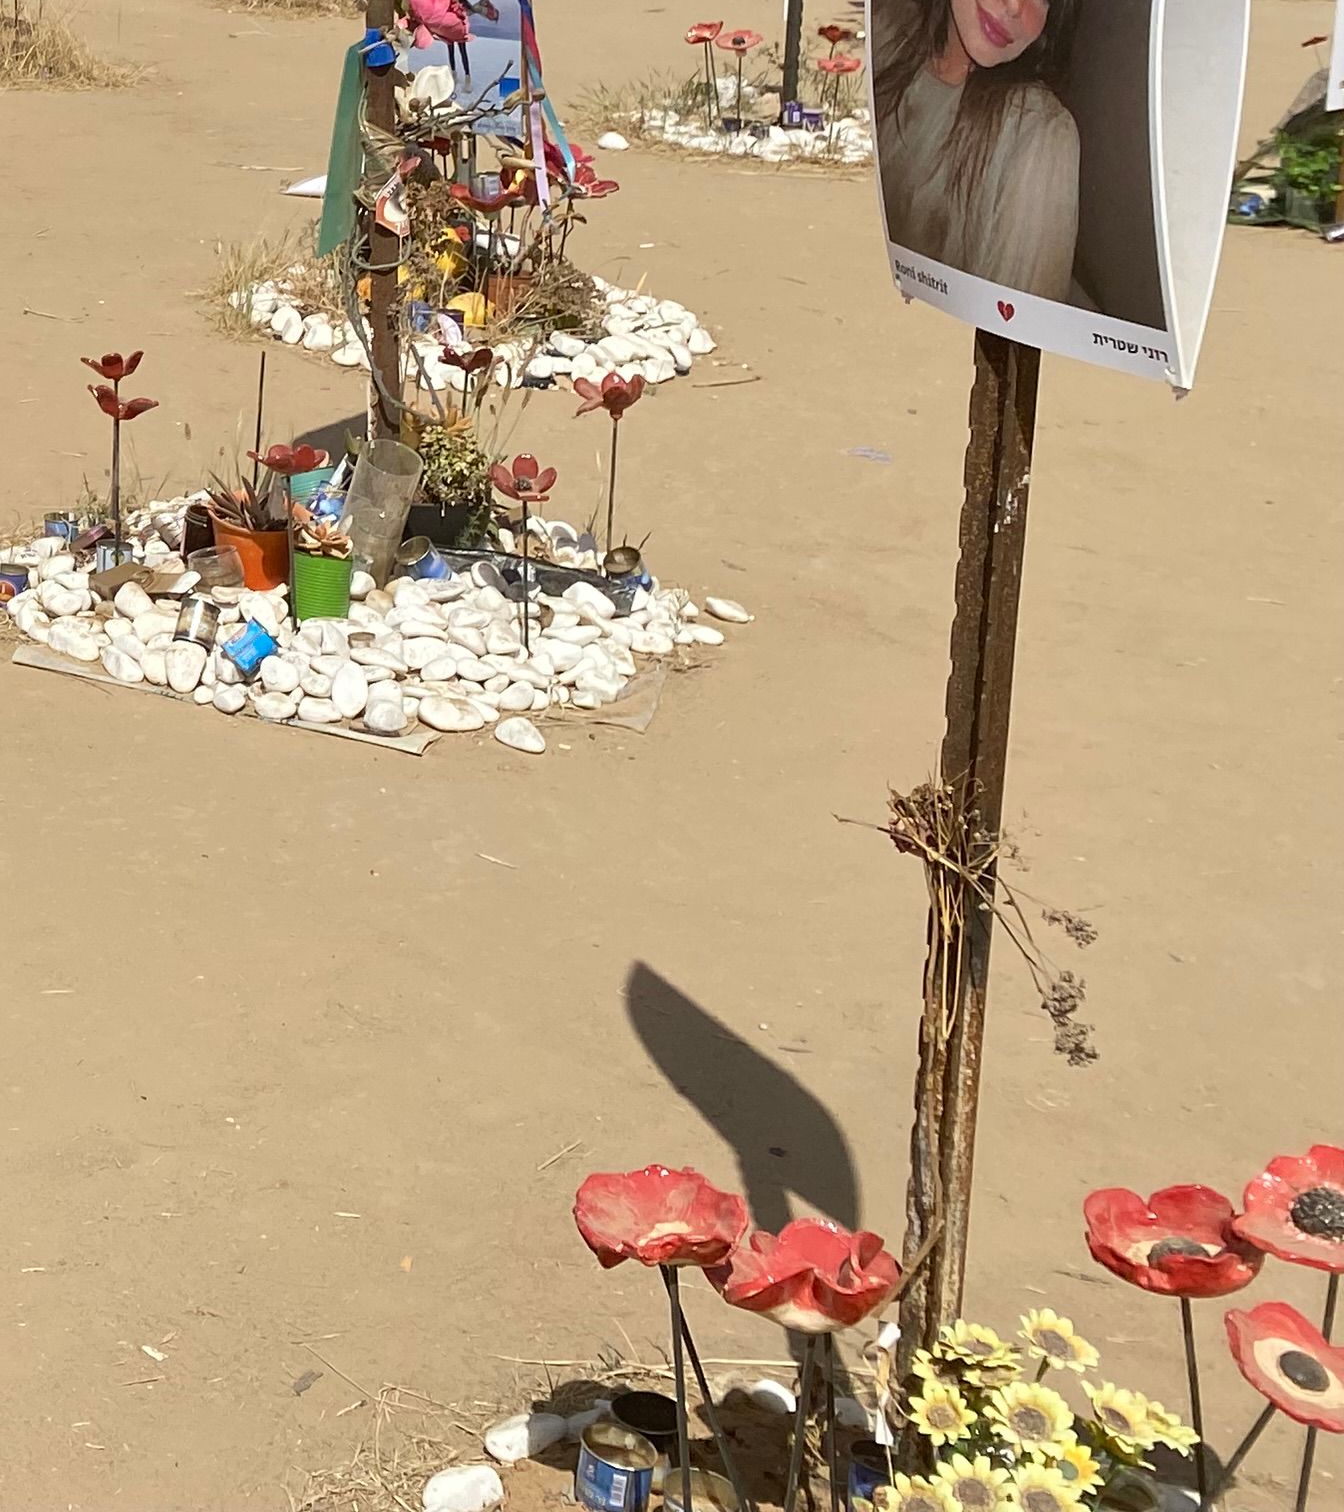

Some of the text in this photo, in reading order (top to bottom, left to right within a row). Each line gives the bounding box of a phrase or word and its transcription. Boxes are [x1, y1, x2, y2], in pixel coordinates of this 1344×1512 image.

[894, 259, 948, 296] Roni shitrit
[1092, 332, 1169, 363] רוני שטרית
